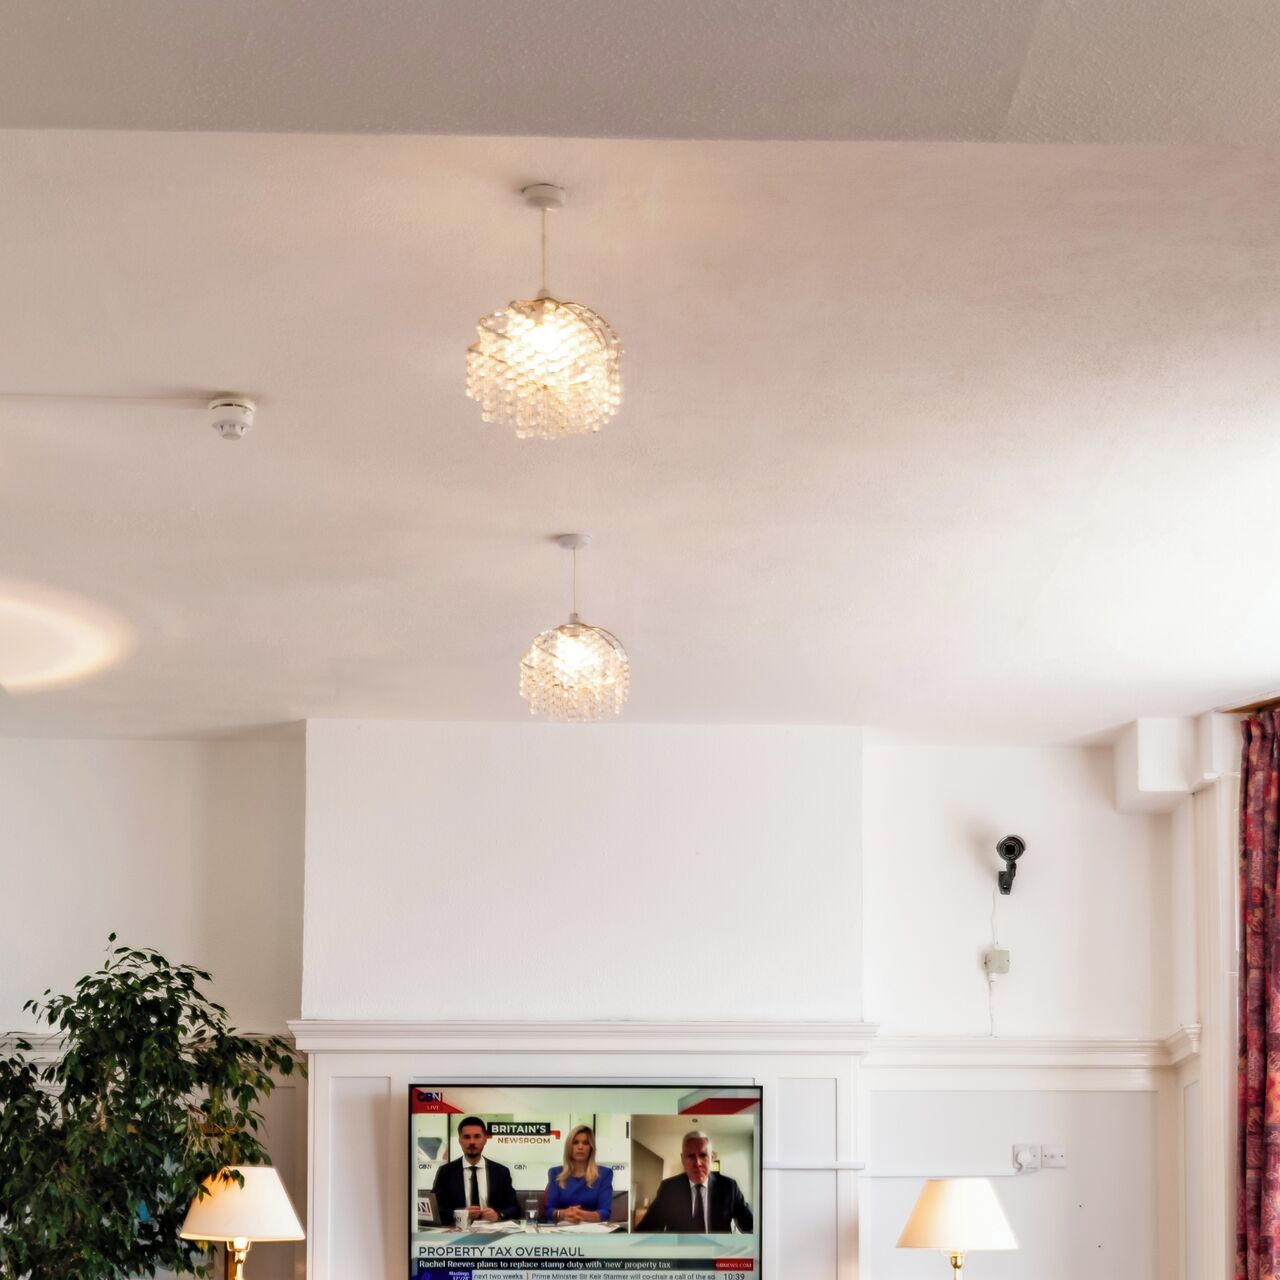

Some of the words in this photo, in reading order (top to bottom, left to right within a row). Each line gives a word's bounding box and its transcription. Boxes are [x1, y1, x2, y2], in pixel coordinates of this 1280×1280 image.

[491, 1124, 547, 1134] BRITAIN'S
[419, 1246, 485, 1257] PROPERTY
[488, 1246, 512, 1257] TAX
[515, 1246, 585, 1257] OVERHAUL
[419, 1260, 446, 1268] Rachel
[447, 1260, 475, 1268] Reeves
[477, 1260, 498, 1270] plans
[500, 1260, 508, 1268] to
[510, 1260, 538, 1270] replace
[540, 1261, 565, 1270] stamp
[566, 1261, 584, 1270] duty
[624, 1262, 657, 1270] property
[723, 1273, 745, 1280] 10:39
